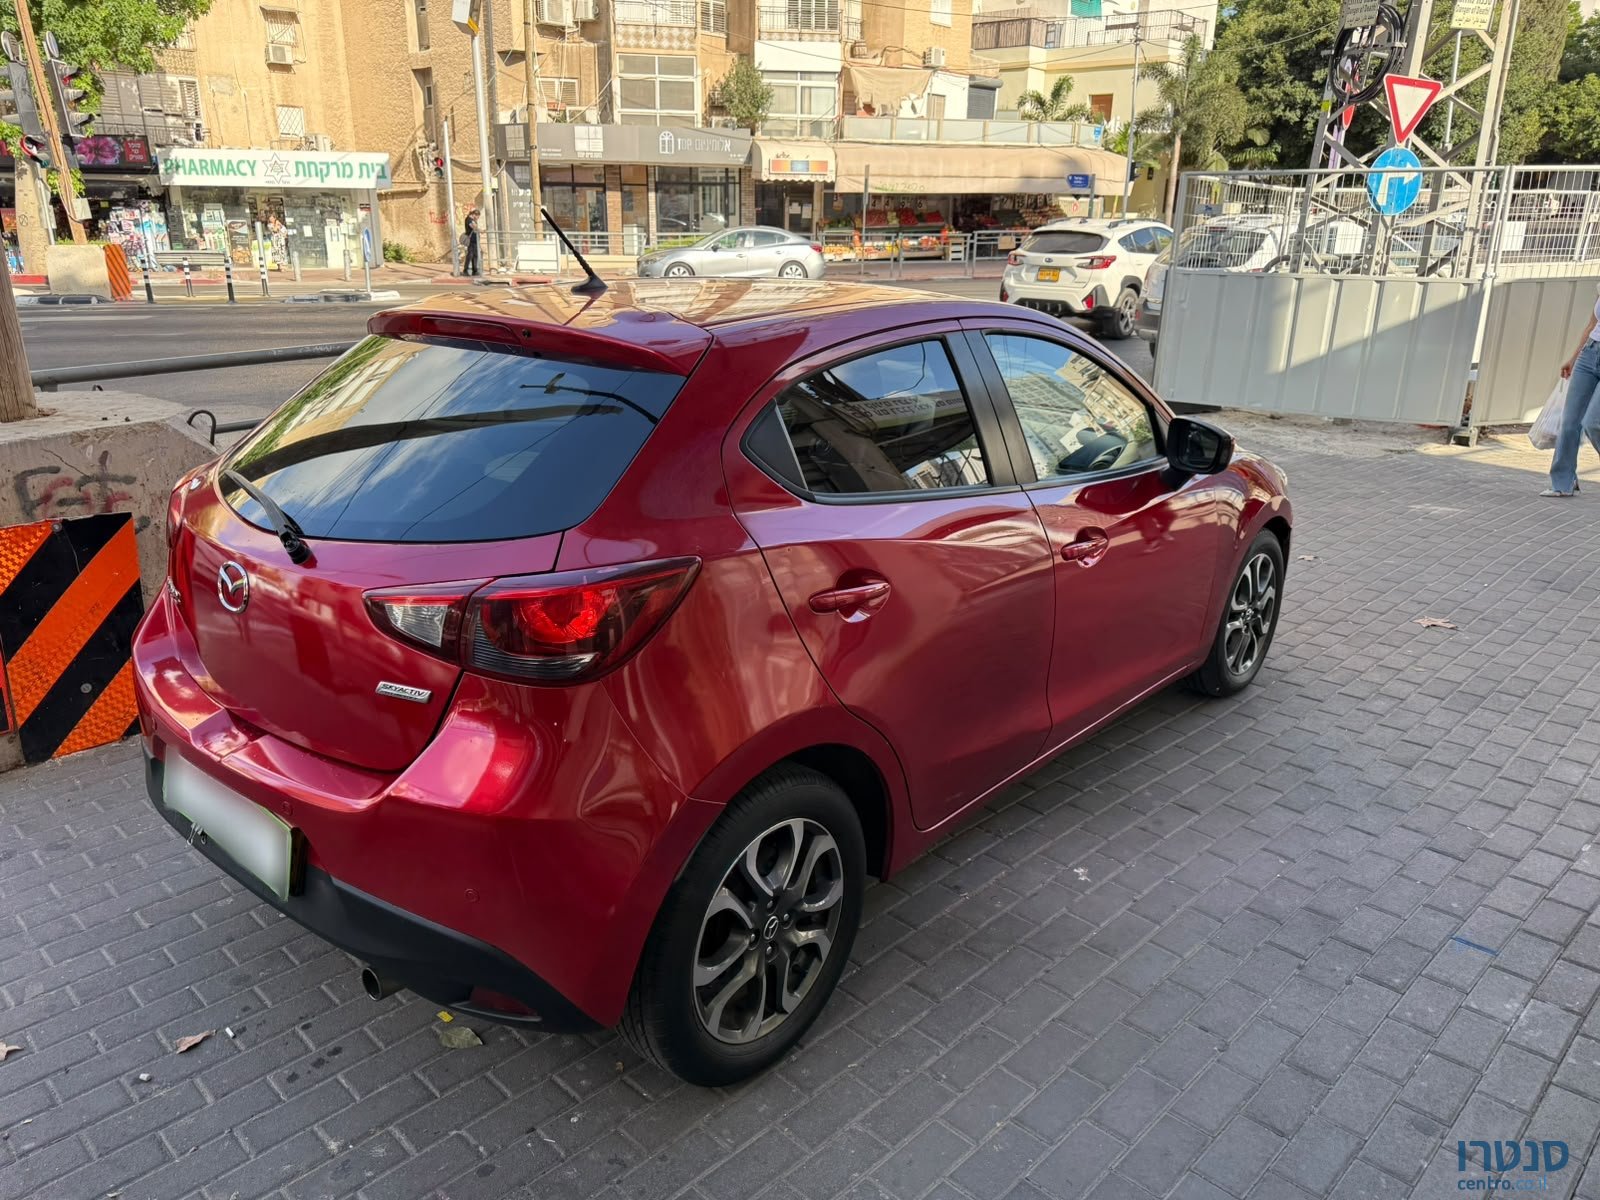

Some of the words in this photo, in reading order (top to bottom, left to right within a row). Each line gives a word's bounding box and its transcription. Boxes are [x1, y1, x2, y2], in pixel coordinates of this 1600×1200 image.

[163, 158, 257, 176] PHARMACY
[294, 161, 354, 183] מרקחת
[358, 162, 387, 179] בית
[381, 683, 426, 696] SKYACTIV
